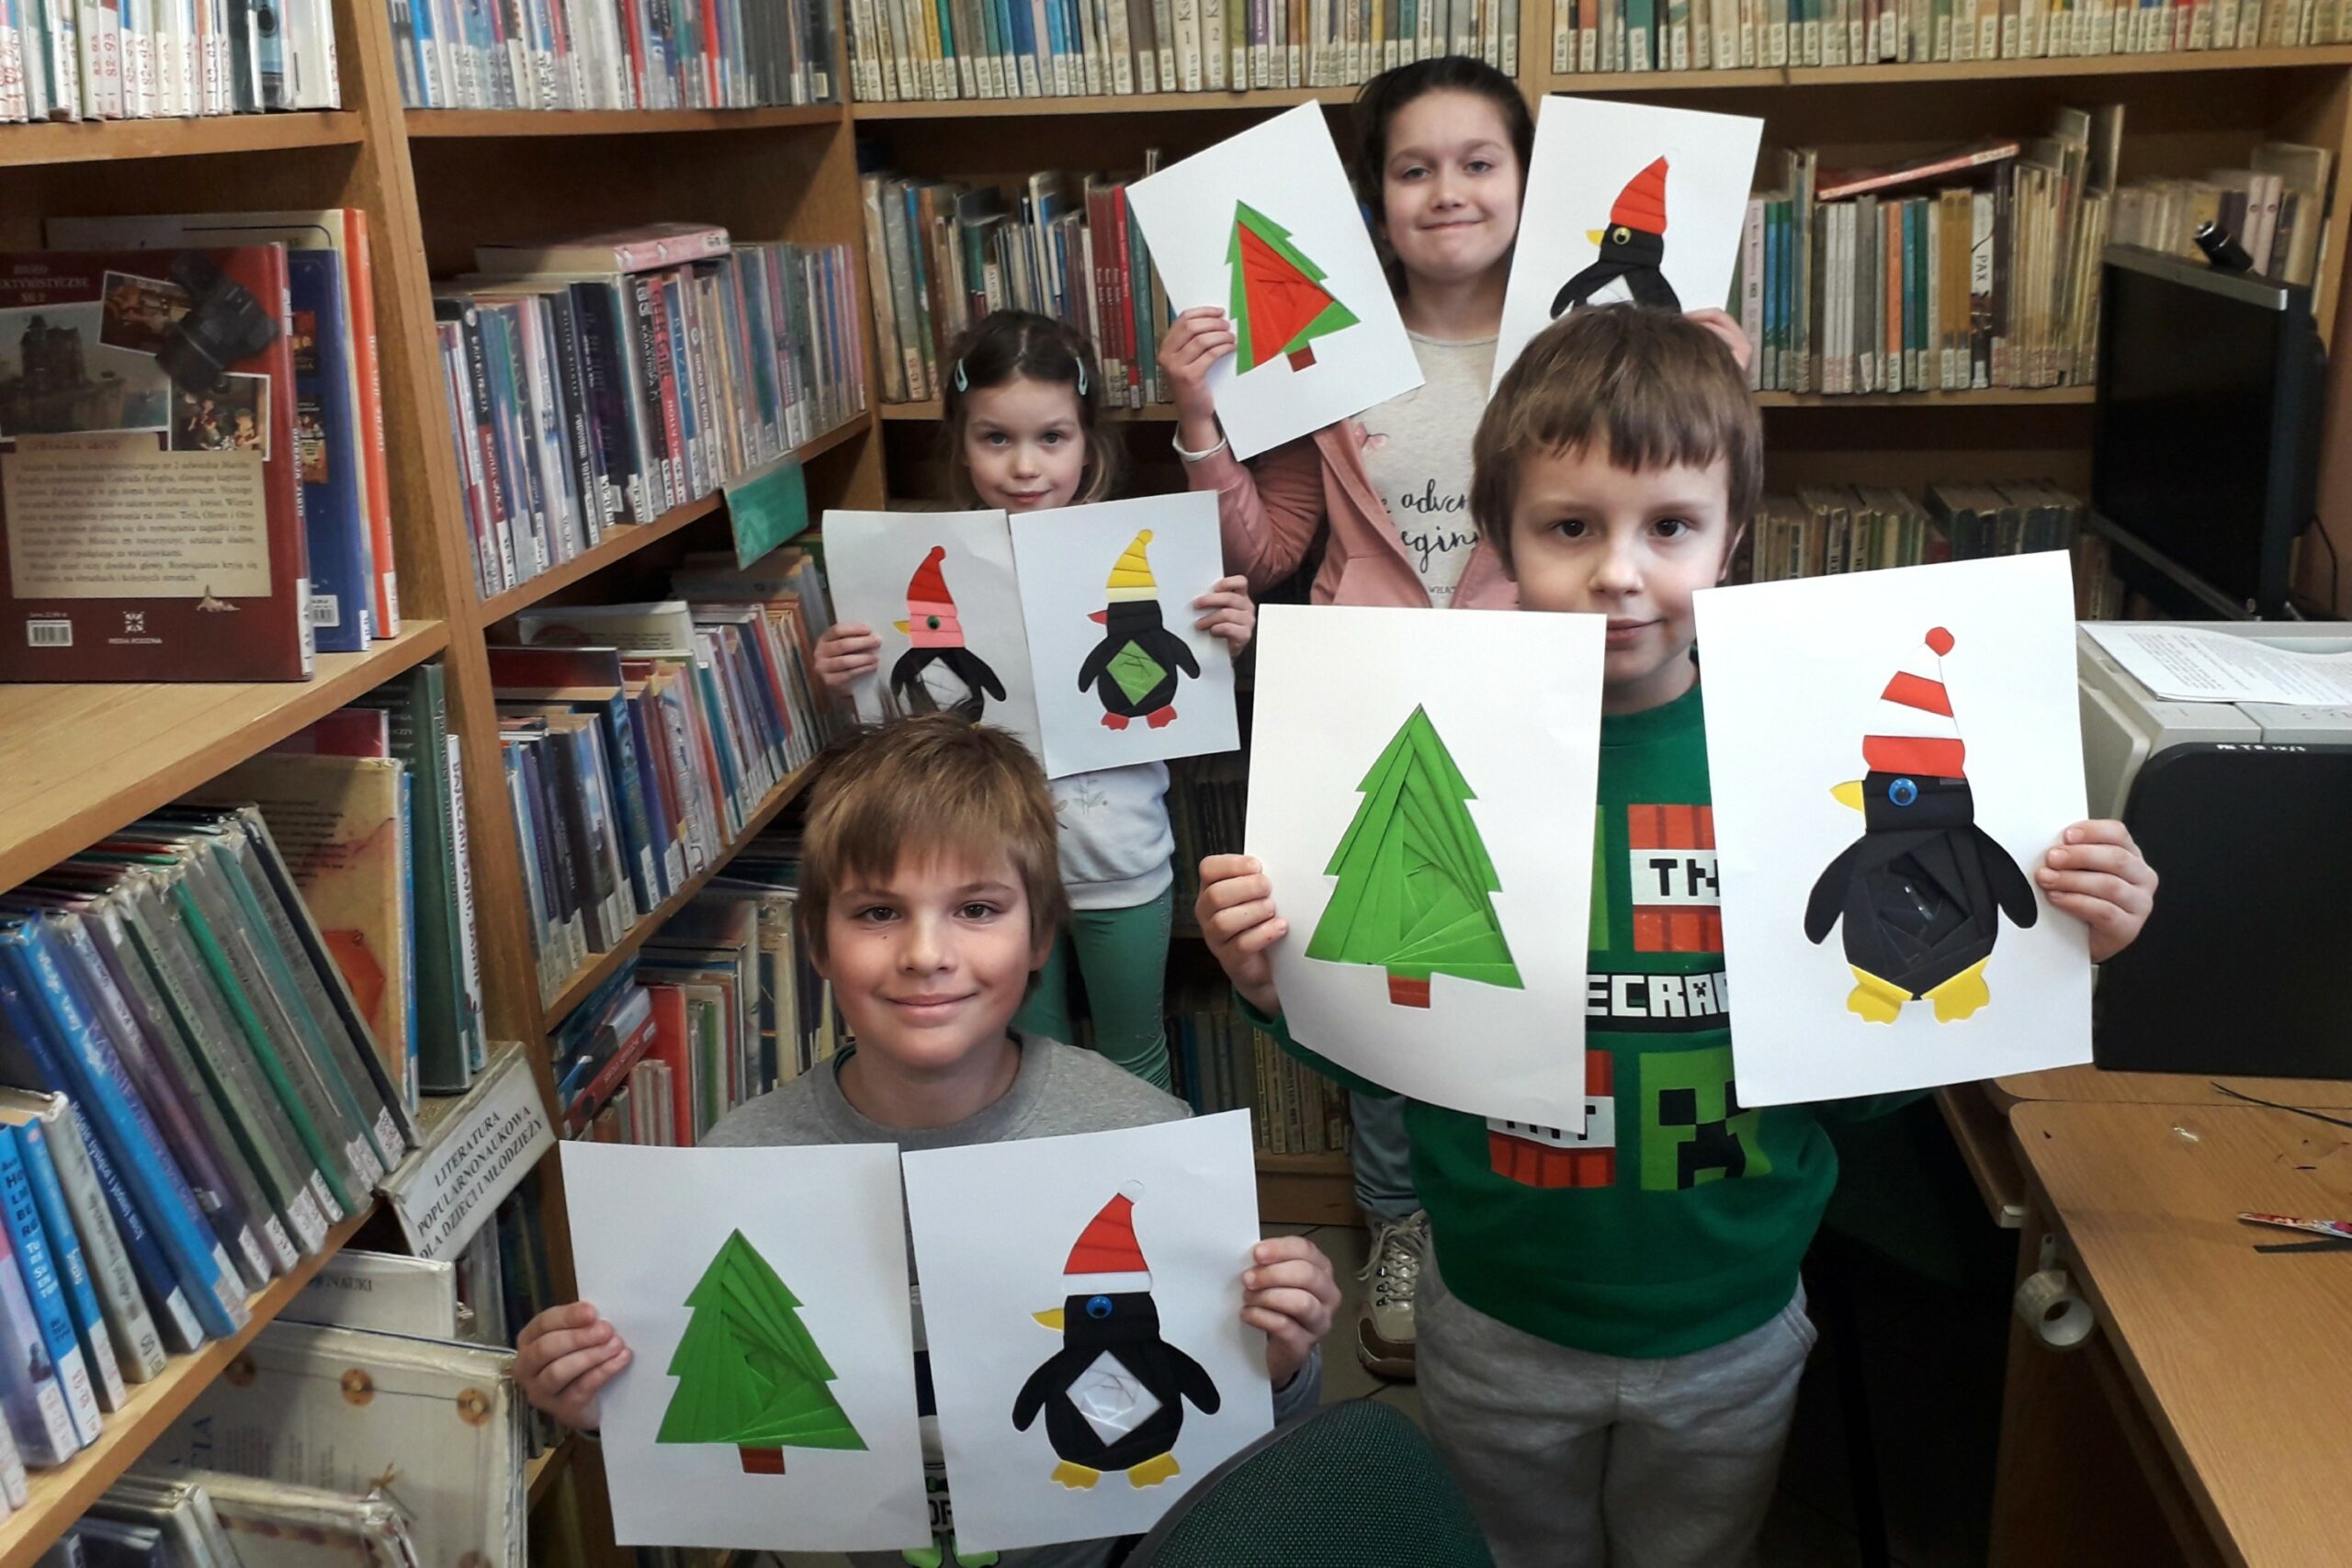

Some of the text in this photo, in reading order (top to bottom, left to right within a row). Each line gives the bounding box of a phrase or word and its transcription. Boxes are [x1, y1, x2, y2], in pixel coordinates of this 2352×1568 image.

[1976, 254, 1988, 283] PAX
[416, 1105, 532, 1238] POPULARNONAUKOWA
[419, 1235, 444, 1259] DLA
[441, 1195, 479, 1237] DZIECI
[482, 1118, 544, 1188] MŁODZIEŻY
[433, 1111, 501, 1188] LITERATURA
